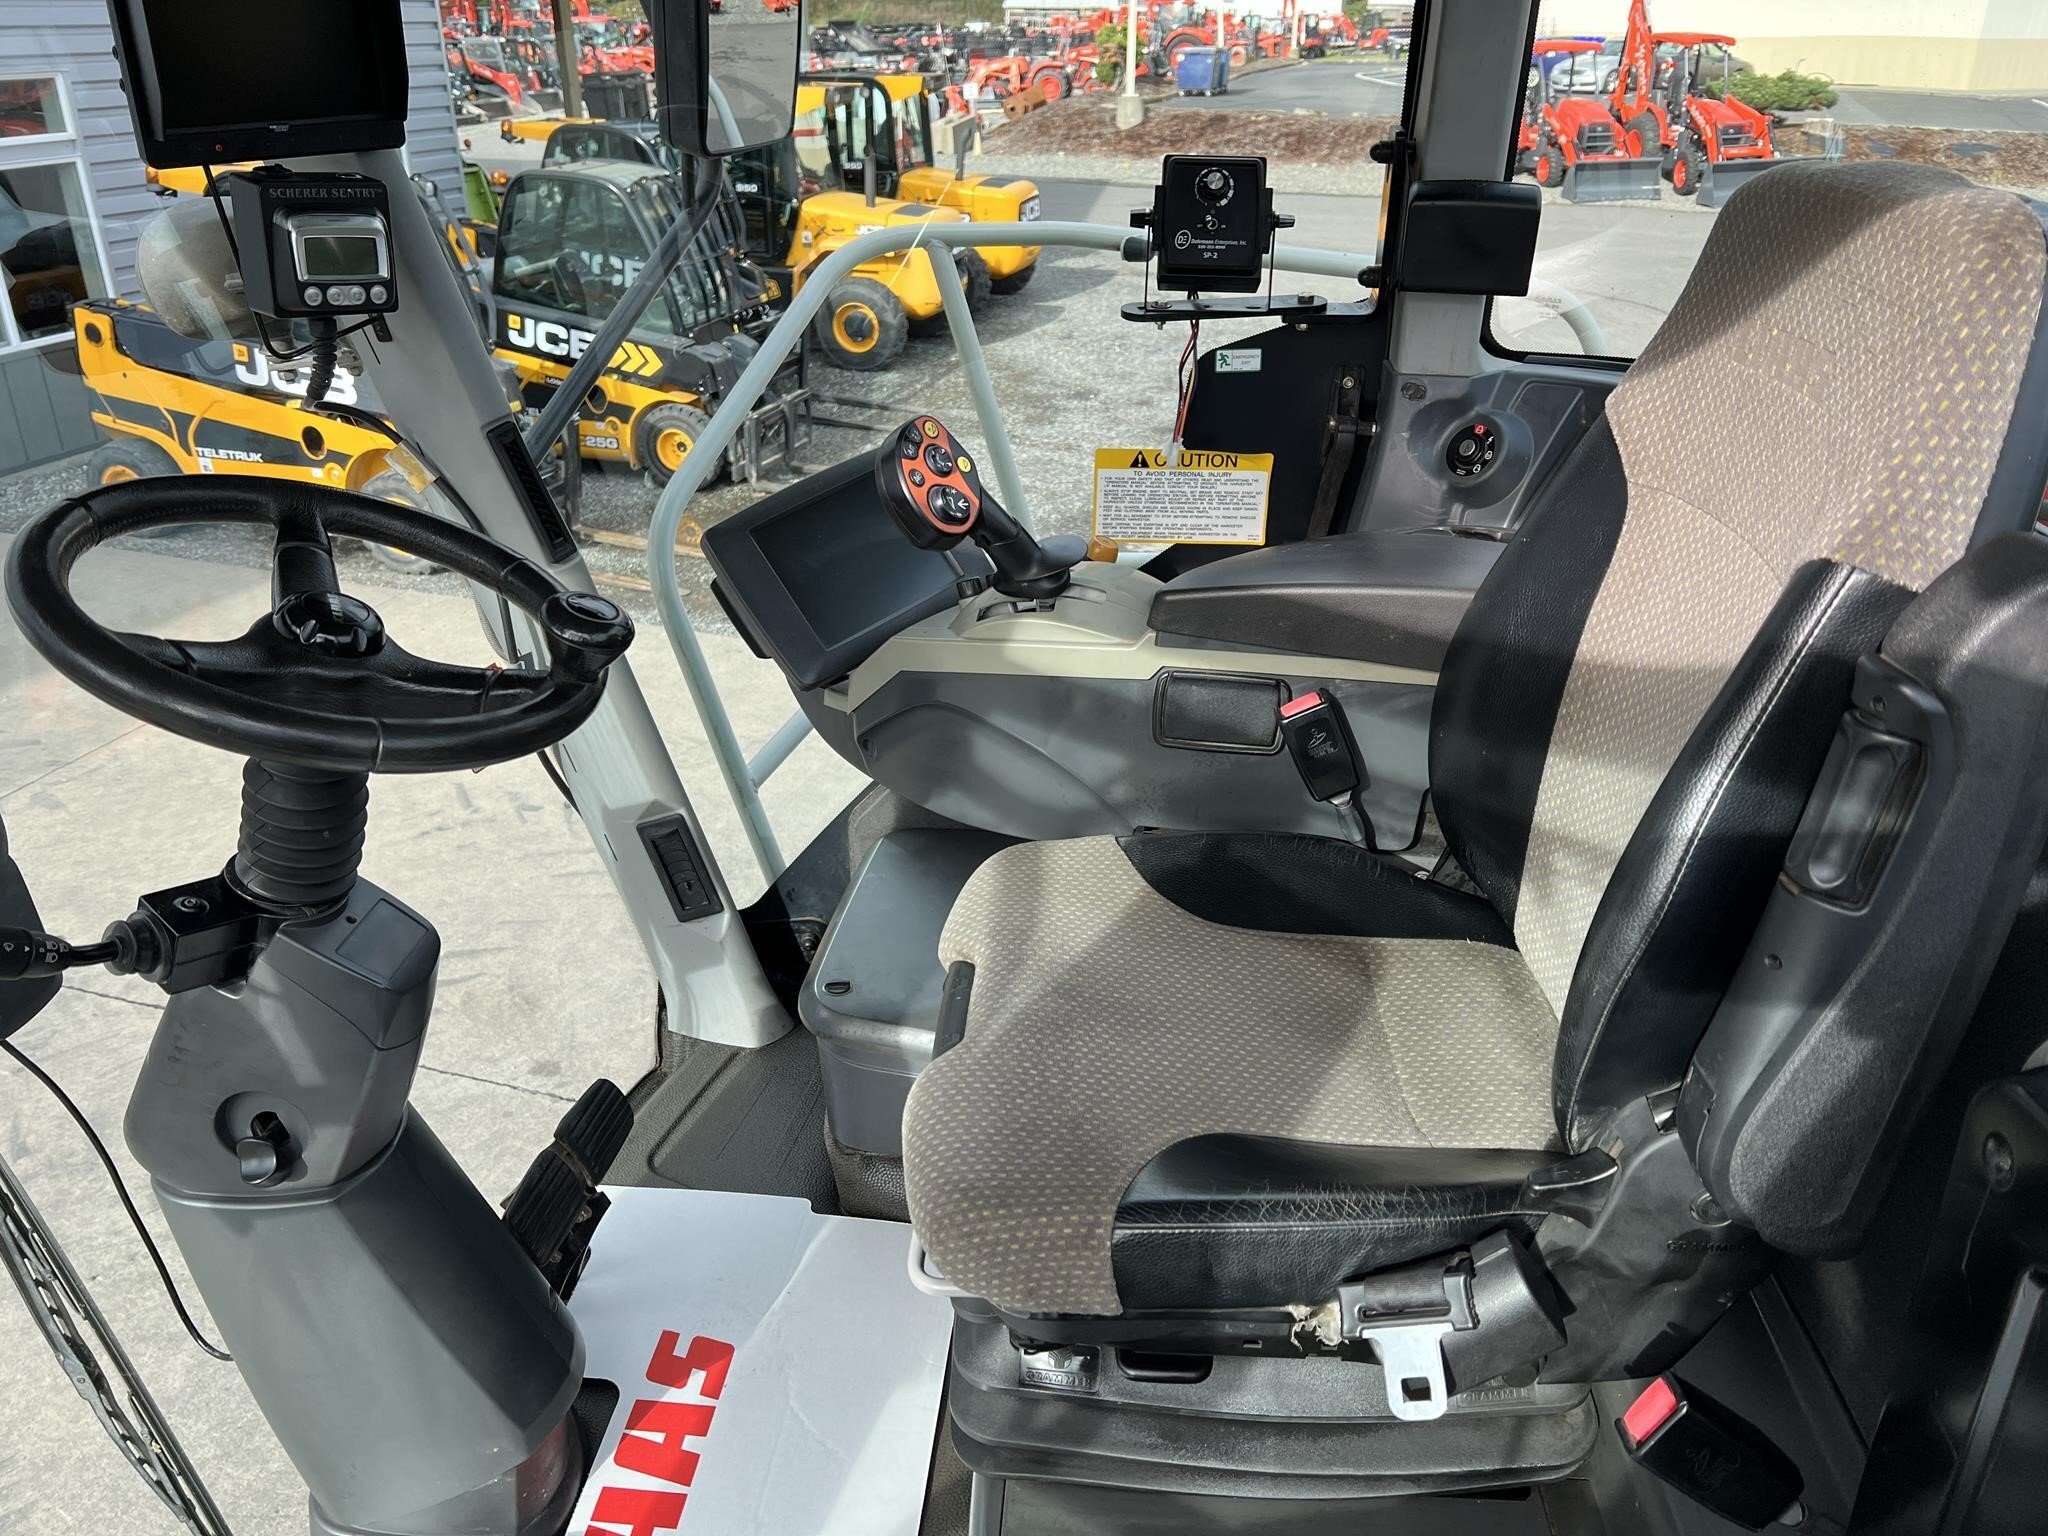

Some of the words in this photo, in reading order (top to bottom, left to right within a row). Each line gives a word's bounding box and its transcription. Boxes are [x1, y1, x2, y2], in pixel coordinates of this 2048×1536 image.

[269, 187, 328, 198] SCHERER
[195, 446, 264, 463] TELETRUK
[1154, 452, 1238, 468] CUTION
